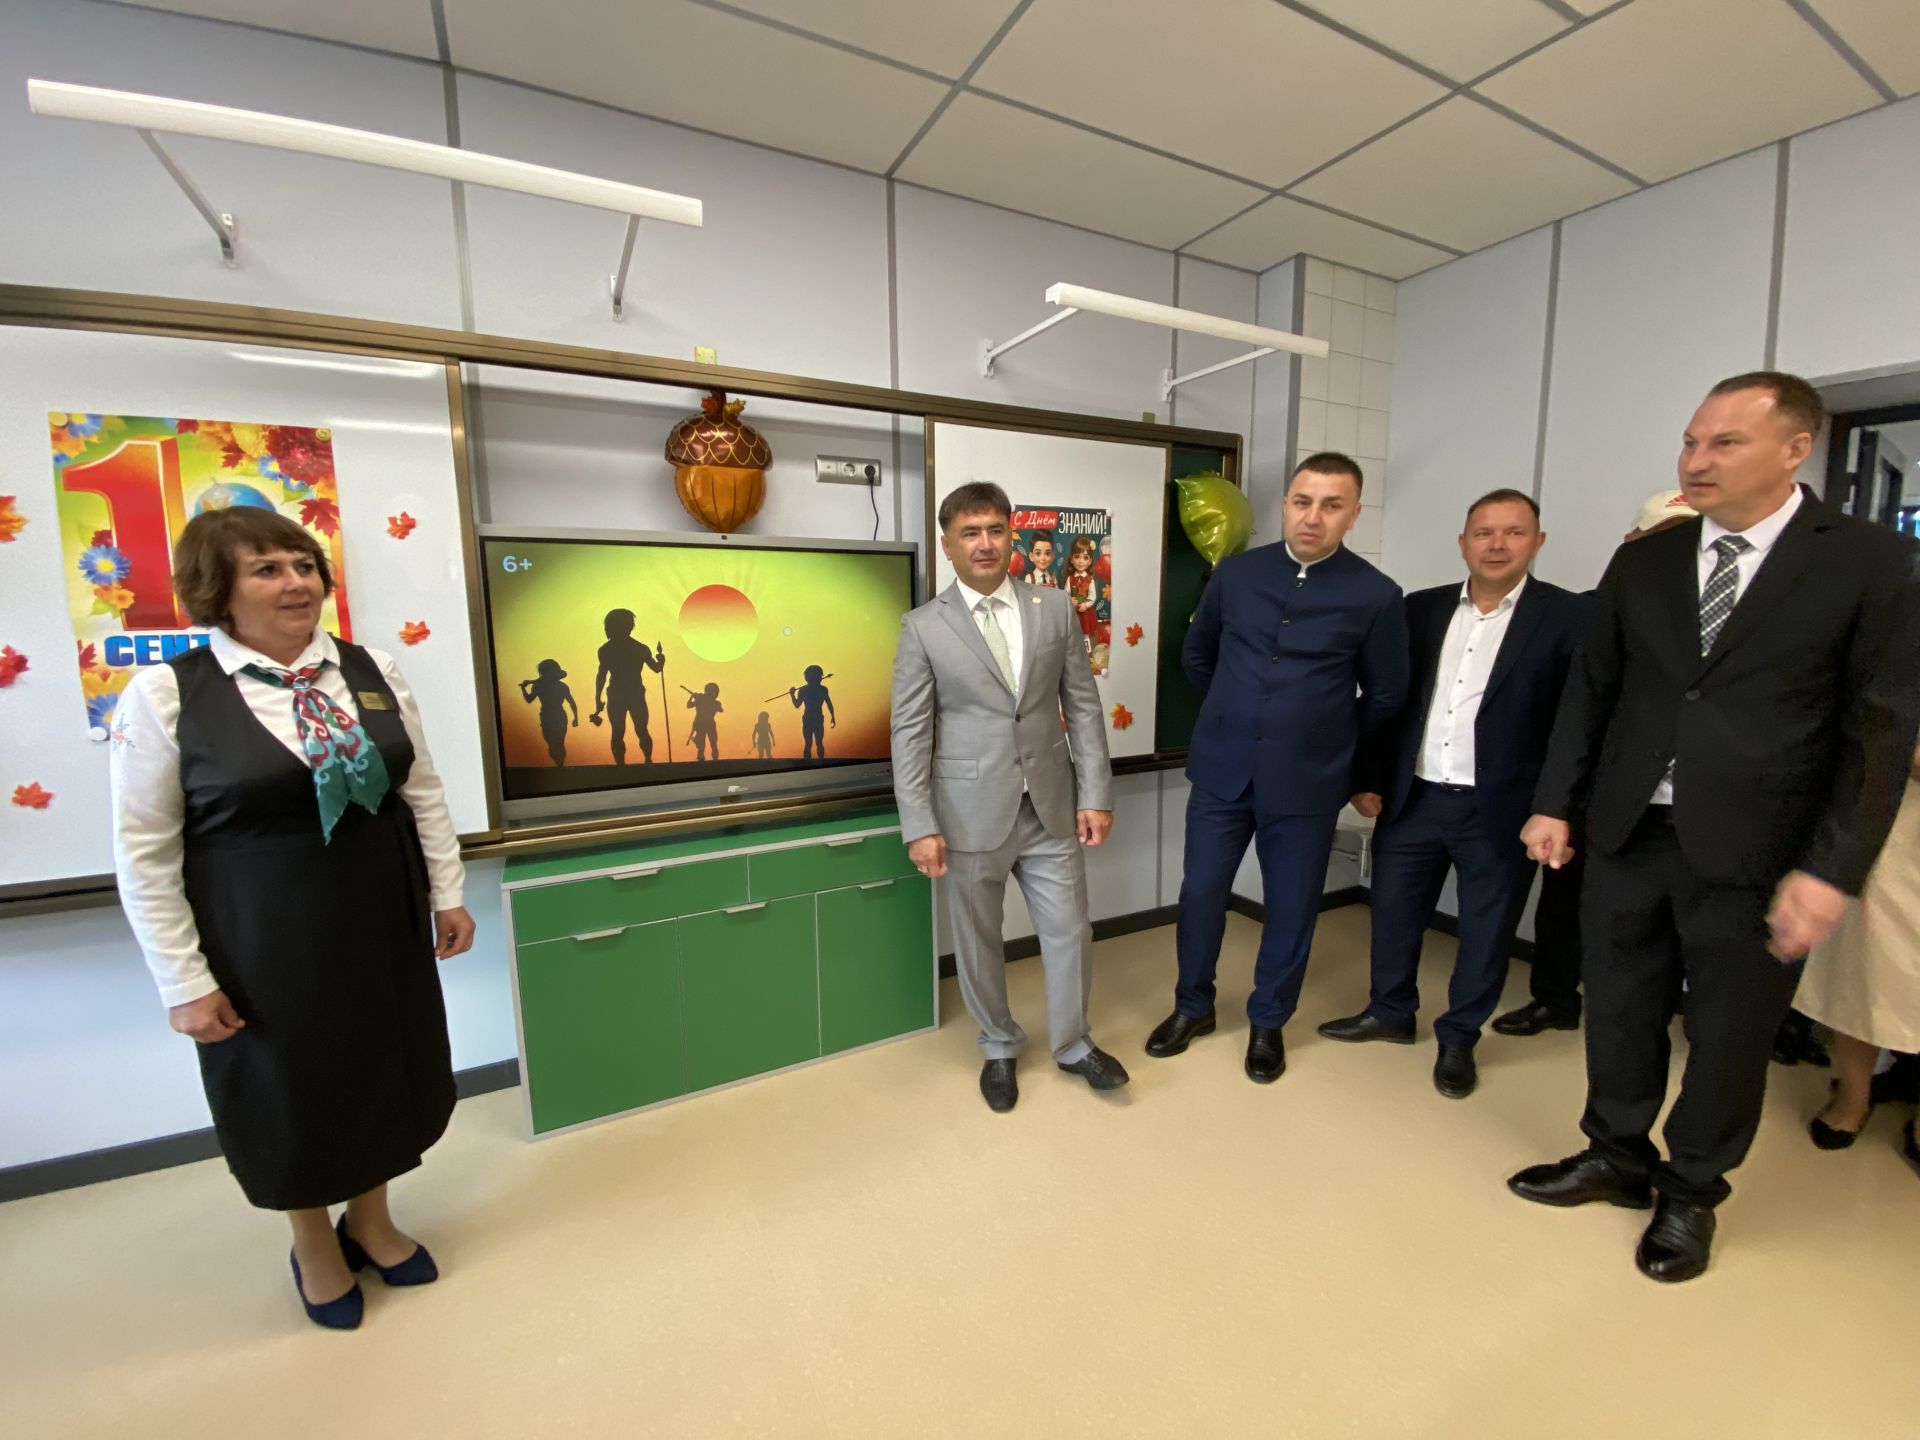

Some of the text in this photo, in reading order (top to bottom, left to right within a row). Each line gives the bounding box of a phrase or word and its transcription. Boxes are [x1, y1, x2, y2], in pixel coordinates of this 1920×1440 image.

[62, 436, 191, 631] 1
[1013, 510, 1107, 535] С Днём ЗНАНИЙ!
[502, 555, 533, 573] 6+
